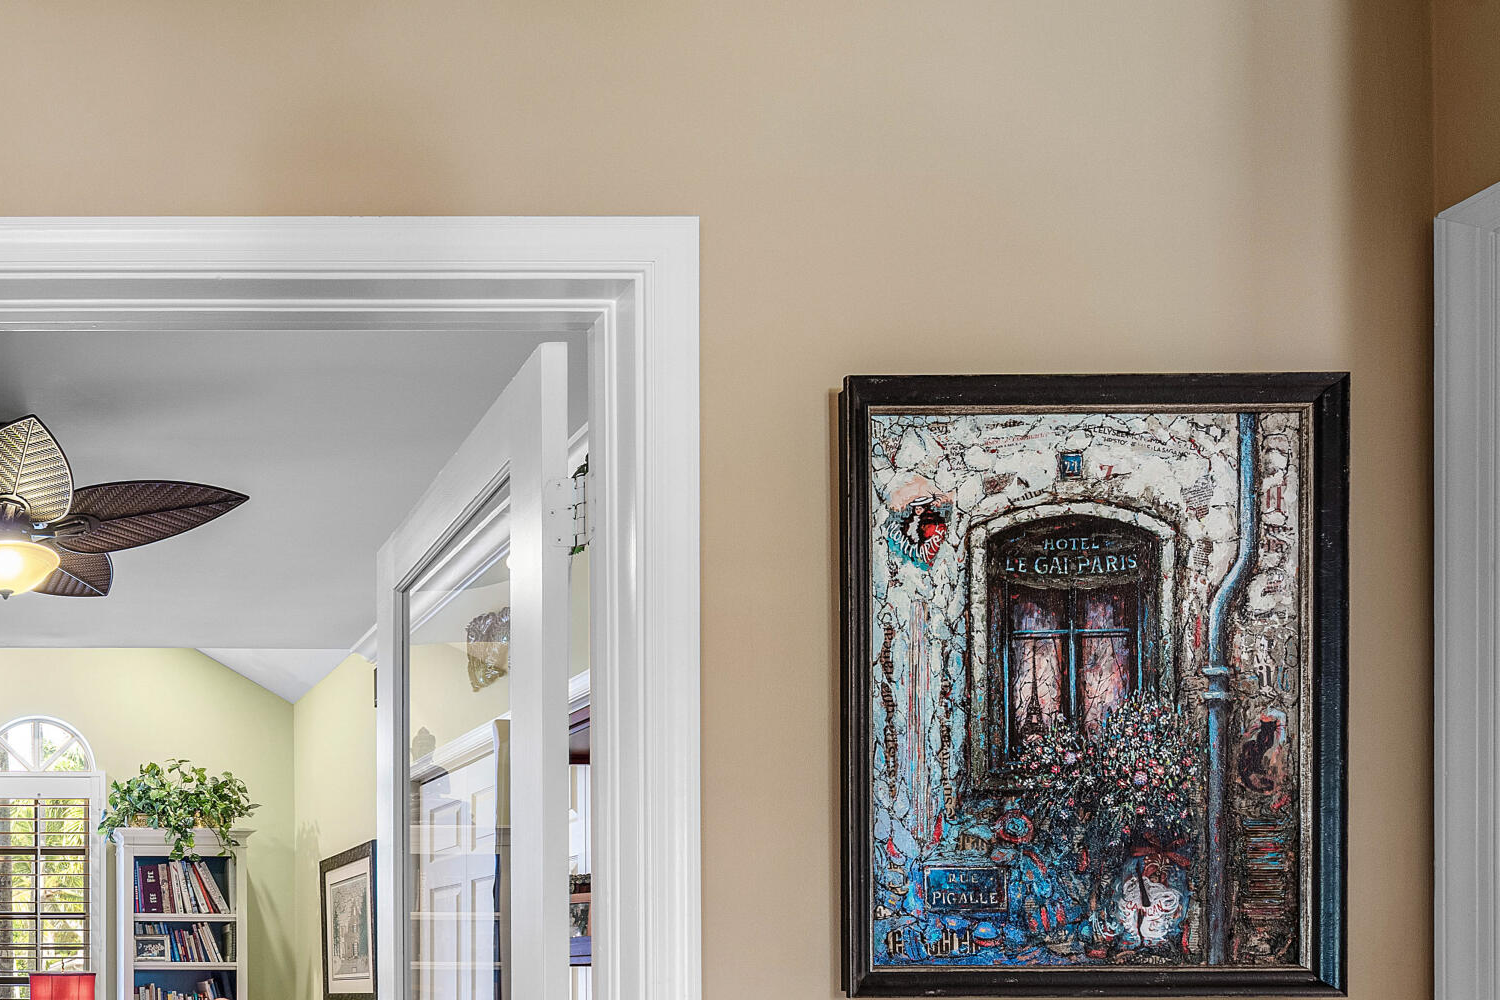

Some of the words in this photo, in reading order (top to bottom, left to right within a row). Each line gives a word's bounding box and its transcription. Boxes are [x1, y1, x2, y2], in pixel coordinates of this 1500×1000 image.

[1064, 461, 1078, 474] 21
[887, 522, 947, 564] MONTMARTRE
[1043, 538, 1100, 551] HOTEL
[1005, 557, 1027, 573] LE
[1034, 556, 1069, 575] GAI
[1077, 553, 1138, 575] PARIS
[947, 873, 979, 884] RUE
[931, 891, 998, 905] PIGALLE
